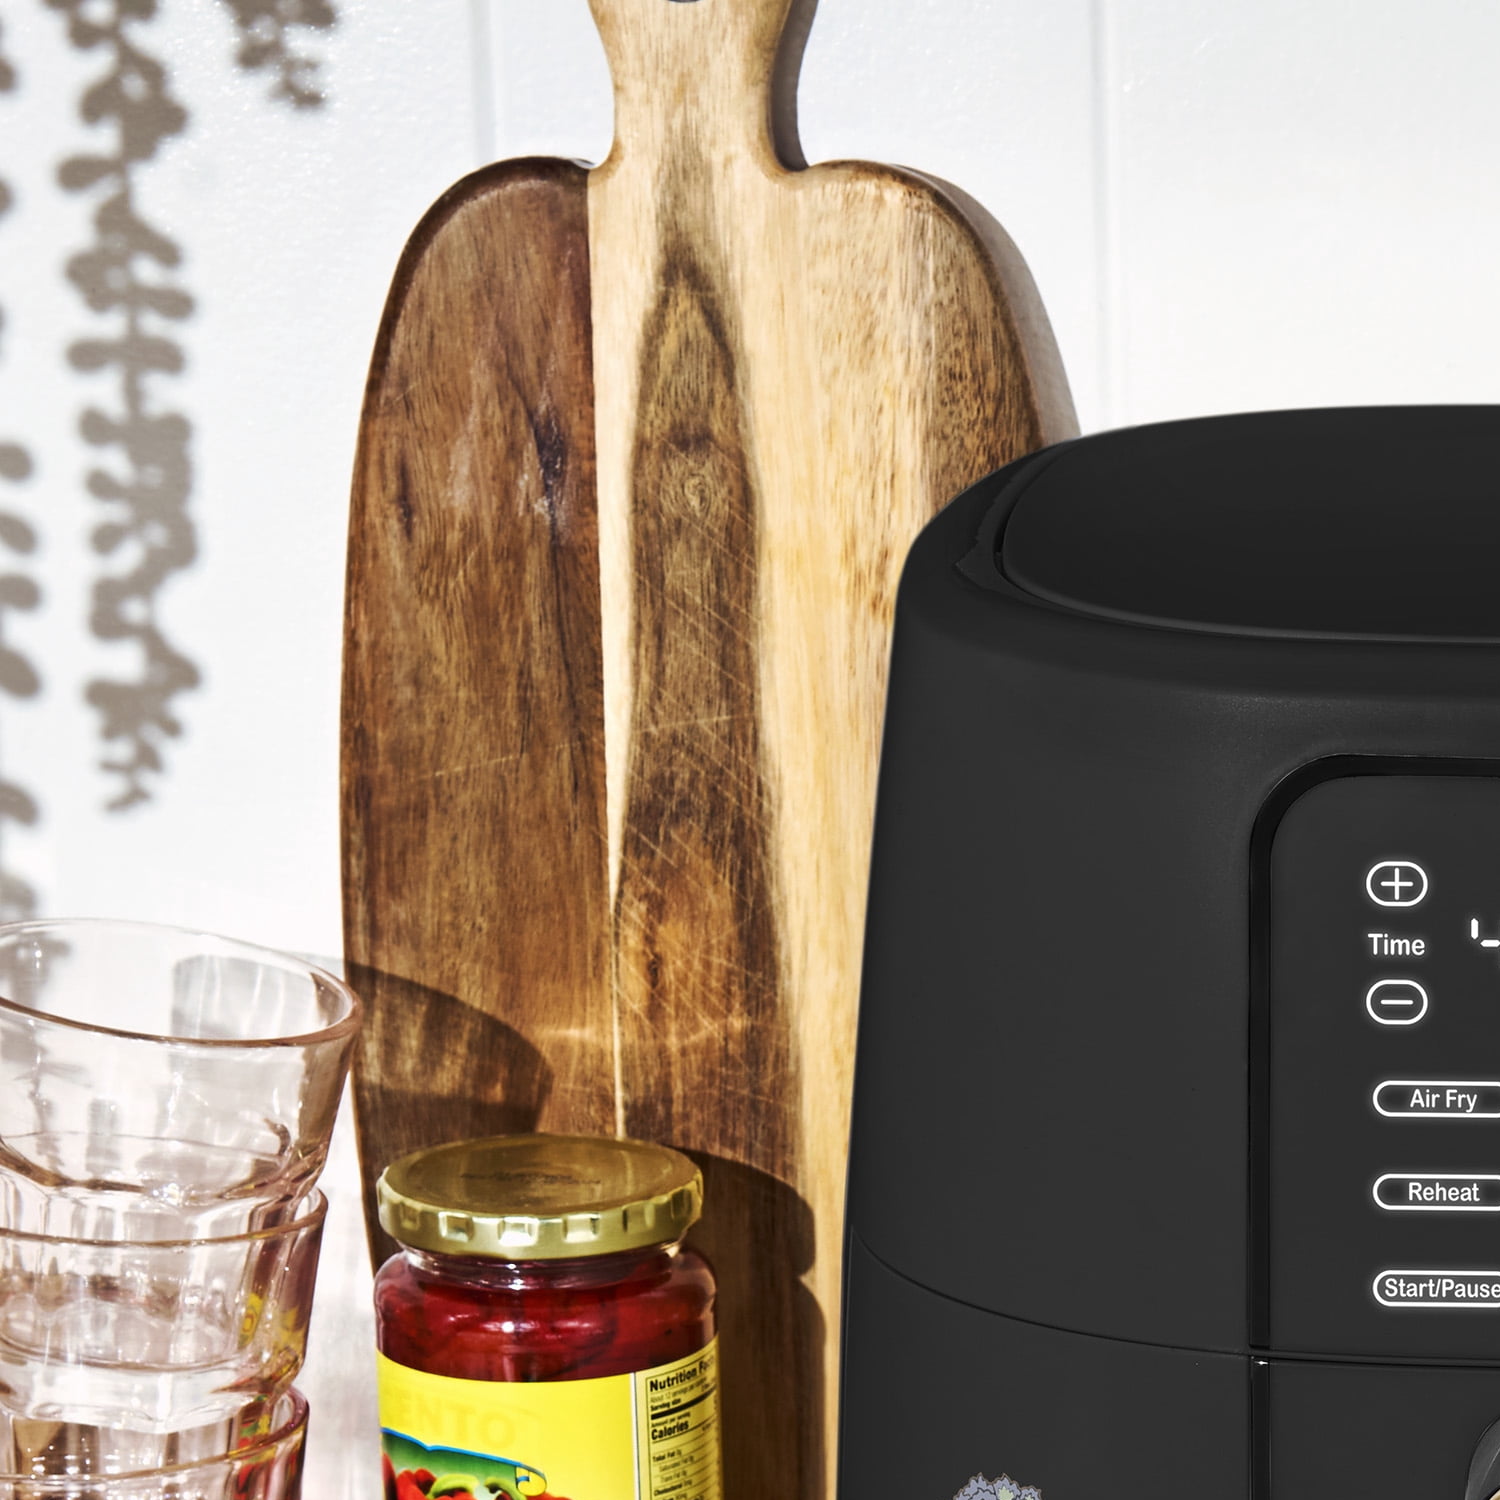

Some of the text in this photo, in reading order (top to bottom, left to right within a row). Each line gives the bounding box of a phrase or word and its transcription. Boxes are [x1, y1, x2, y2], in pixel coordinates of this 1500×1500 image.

[1368, 932, 1426, 956] Time
[1409, 1088, 1478, 1113] Air Fry
[1408, 1181, 1480, 1202] Reheat
[650, 1368, 697, 1392] Nutrition
[651, 1421, 689, 1441] Calories
